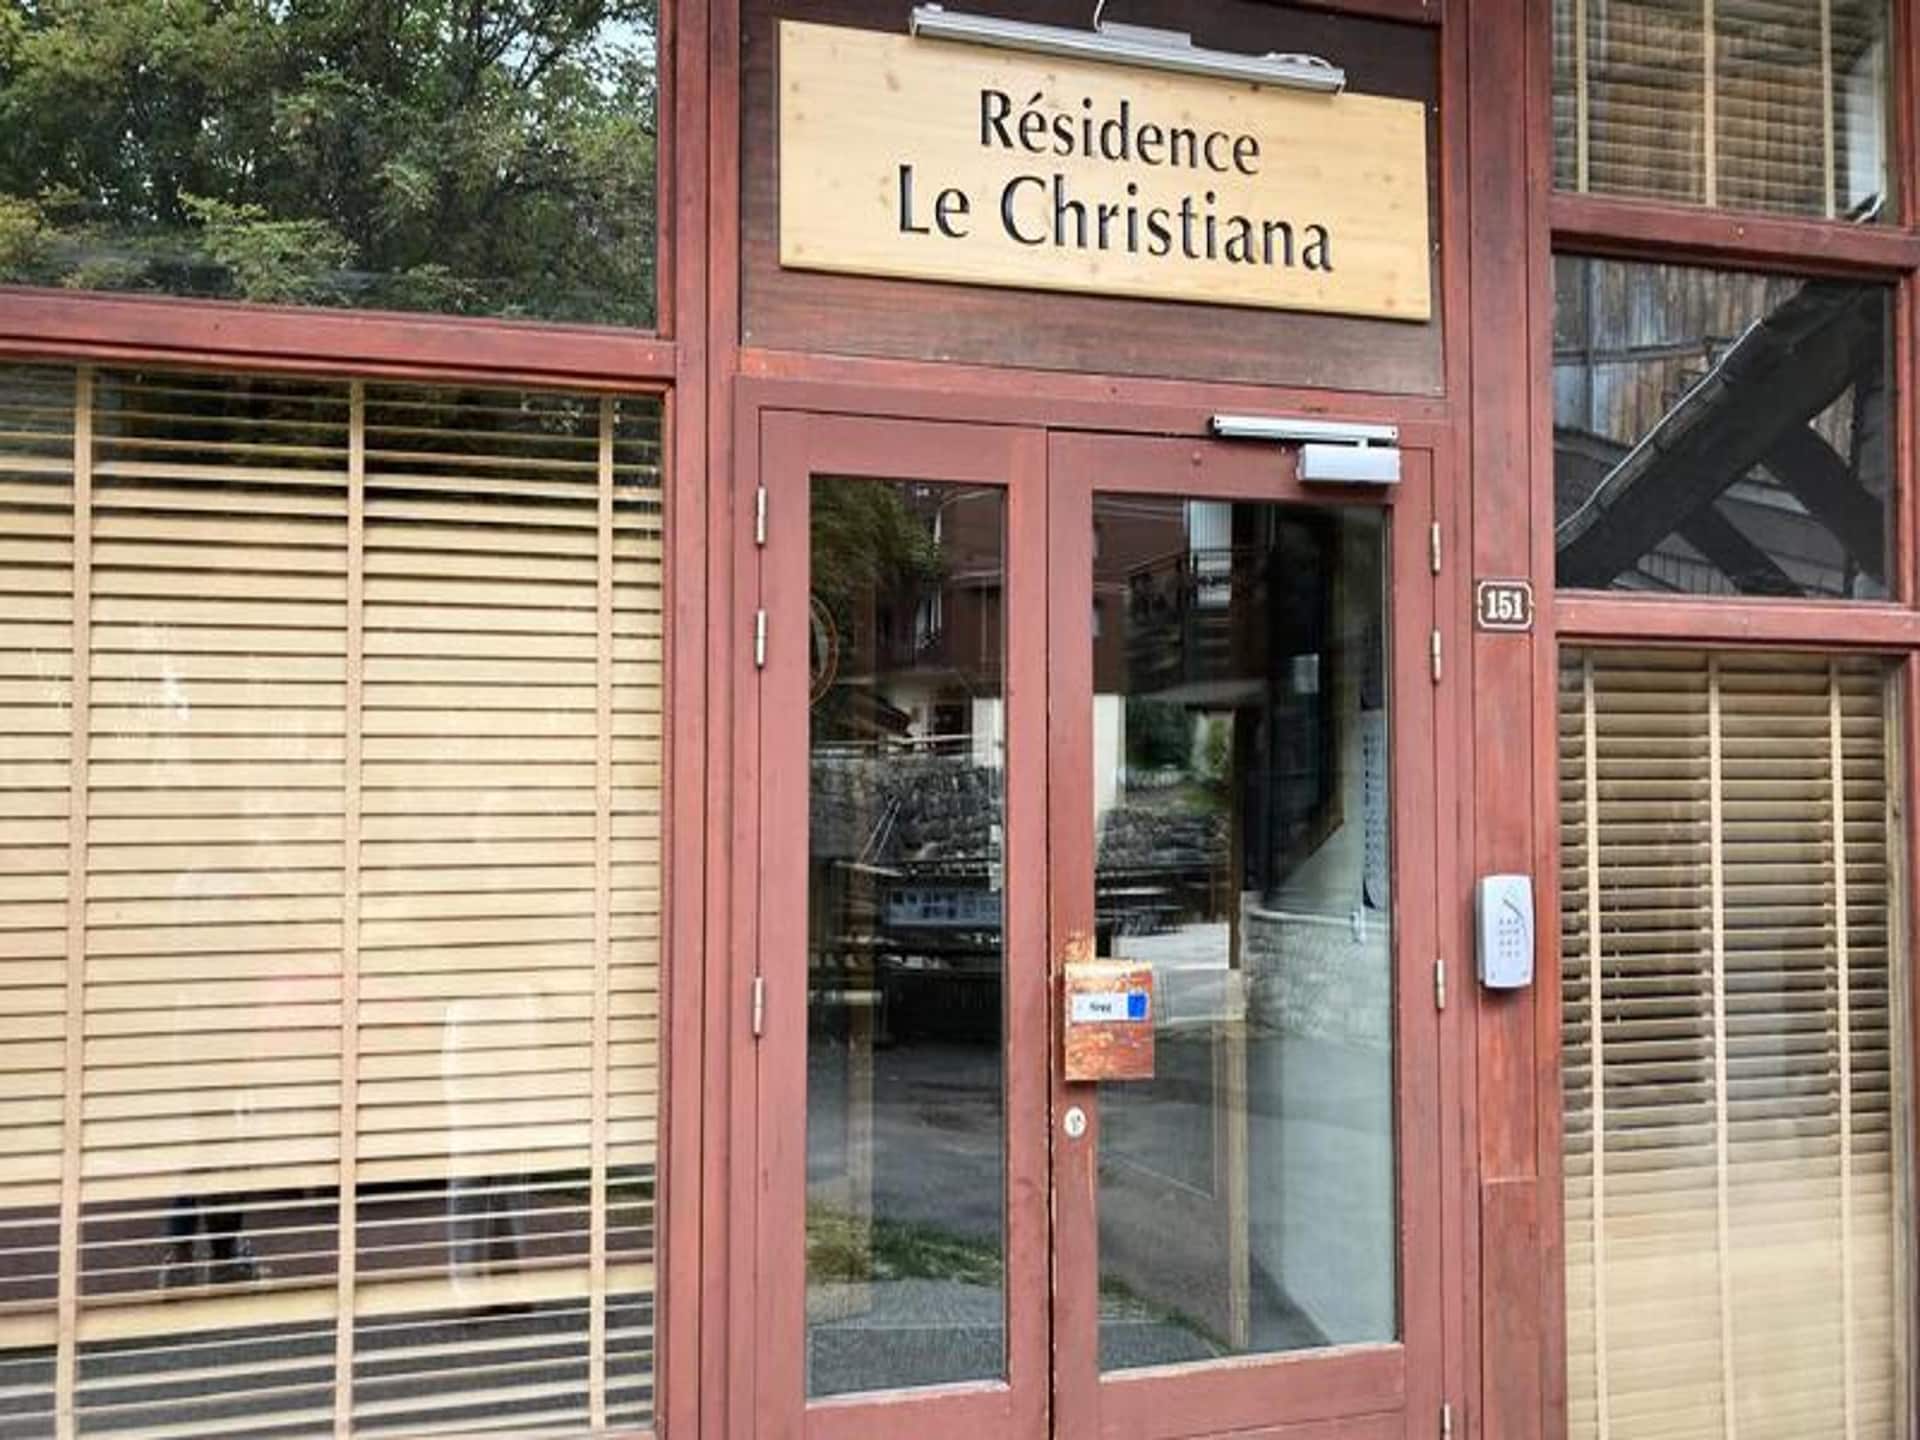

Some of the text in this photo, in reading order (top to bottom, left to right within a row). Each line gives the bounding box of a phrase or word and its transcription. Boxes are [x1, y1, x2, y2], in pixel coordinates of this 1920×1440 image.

[980, 89, 1261, 175] Résidence
[899, 164, 1334, 272] Le Christiana
[1487, 589, 1523, 620] 151
